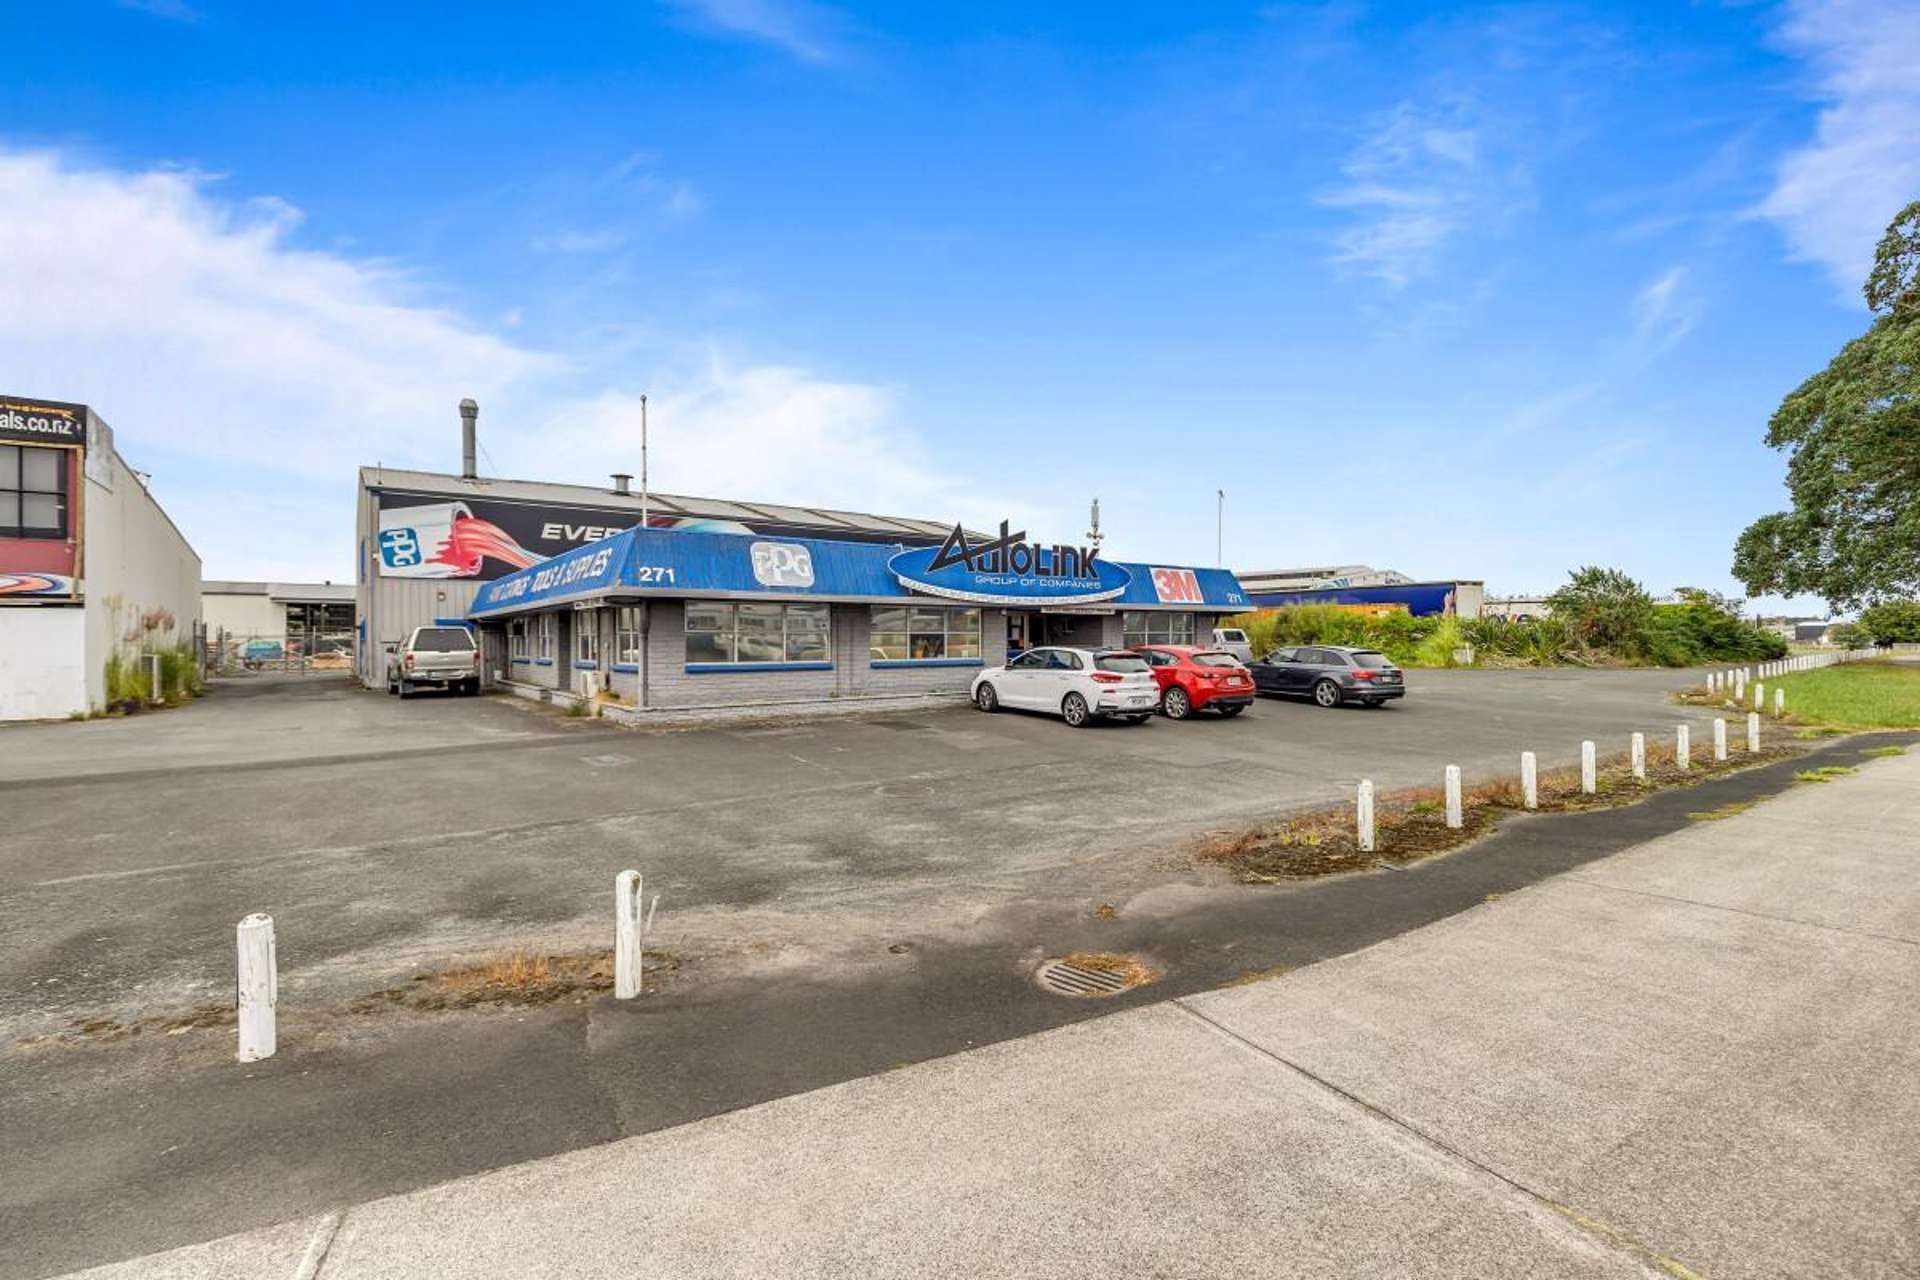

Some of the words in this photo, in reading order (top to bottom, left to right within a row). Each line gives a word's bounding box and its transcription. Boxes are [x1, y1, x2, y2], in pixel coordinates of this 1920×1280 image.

[0, 411, 73, 435] als.co.nz
[640, 567, 675, 583] 271
[754, 547, 811, 583] PPG
[975, 575, 1016, 586] GROUP
[1020, 578, 1038, 587] OF
[1040, 578, 1102, 590] COMPANIES
[1153, 568, 1202, 602] 3M
